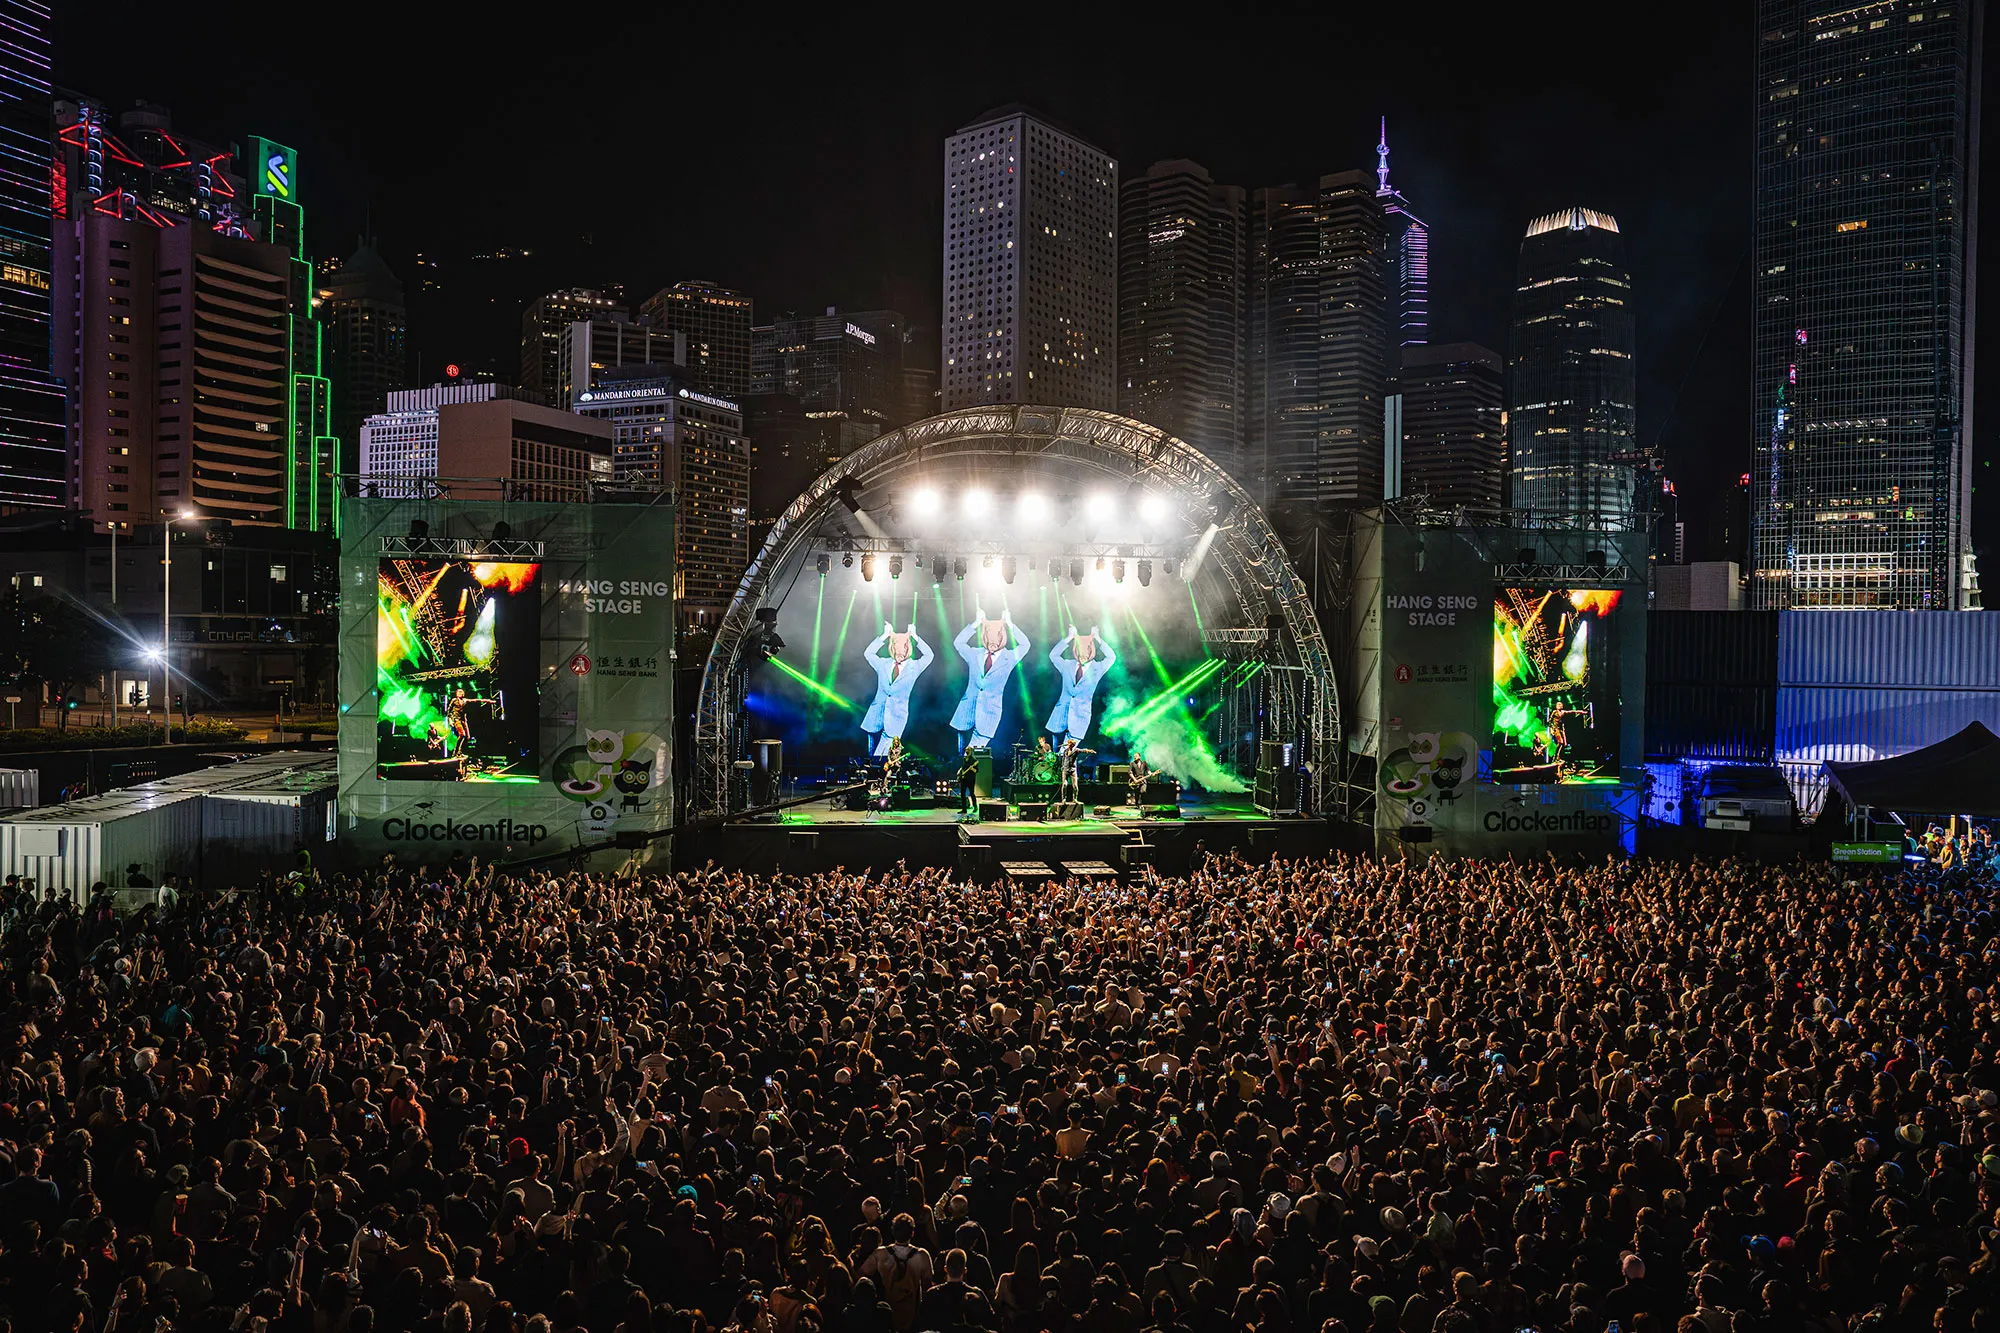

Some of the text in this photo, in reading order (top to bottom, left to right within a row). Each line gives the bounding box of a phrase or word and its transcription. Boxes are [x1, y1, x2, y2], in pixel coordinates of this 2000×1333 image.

[594, 388, 666, 400] MANDARIN ORIENTAL
[690, 391, 740, 412] MANDARIN ORIENTAL
[559, 579, 668, 596] HANG SENG
[585, 598, 642, 614] STAGE
[1387, 595, 1478, 609] HANG SENG
[1408, 612, 1456, 626] STAGE
[209, 631, 234, 641] CITY
[596, 655, 657, 669] 恒生銀行
[1483, 810, 1612, 835] Clockenflap
[382, 817, 548, 846] Clockenflap
[1833, 847, 1856, 855] Green
[1857, 847, 1882, 856] Station
